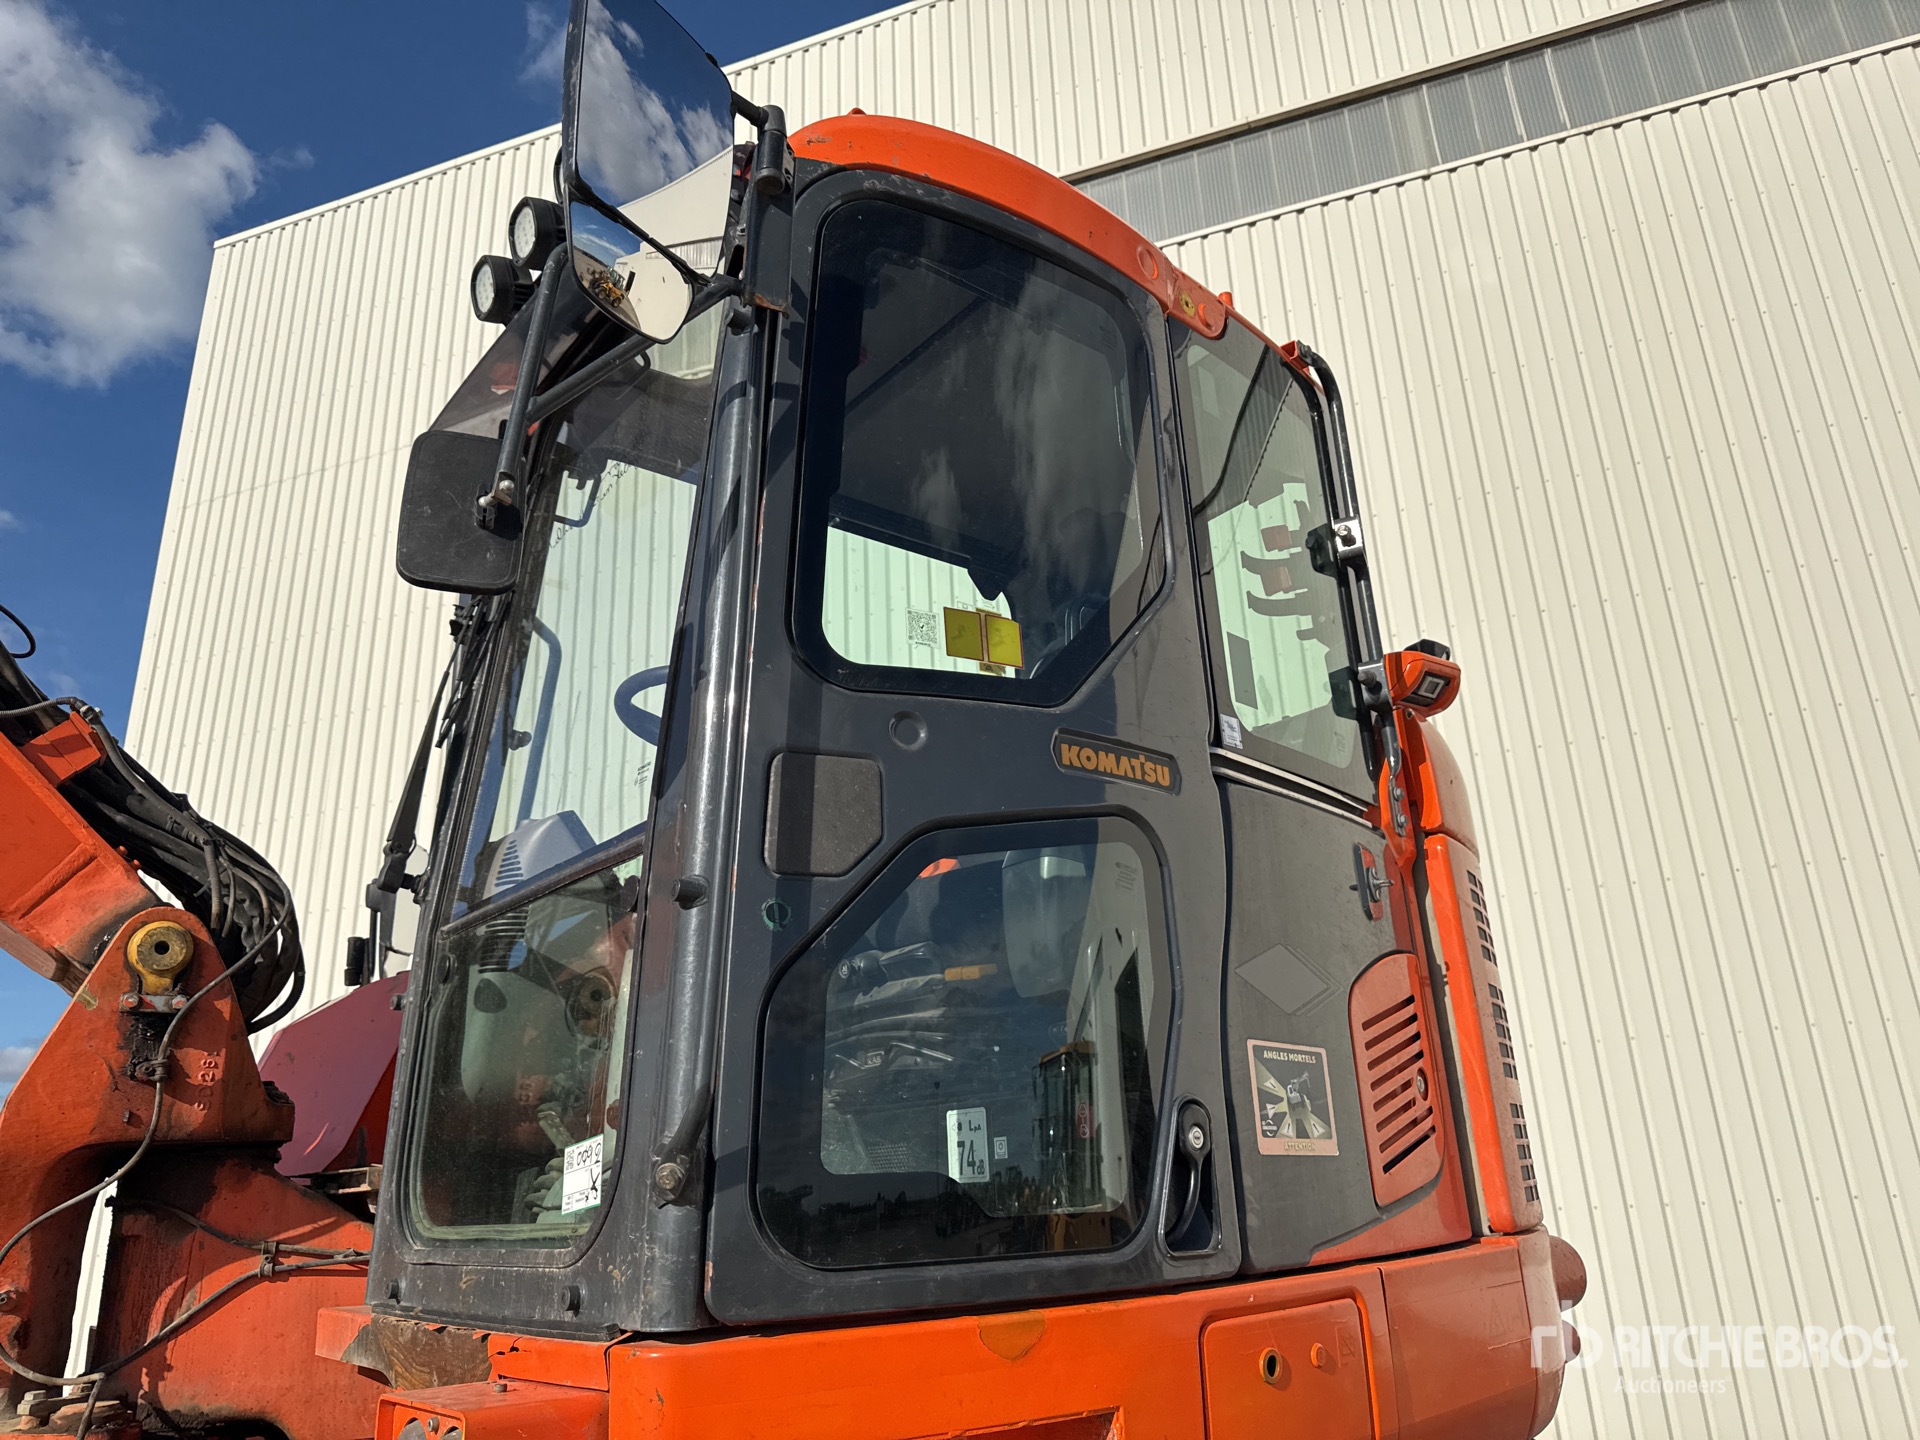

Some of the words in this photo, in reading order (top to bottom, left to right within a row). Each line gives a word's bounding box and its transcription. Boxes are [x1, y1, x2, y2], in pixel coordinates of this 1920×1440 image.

[1060, 743, 1171, 786] KOMATSU
[1263, 1050, 1288, 1061] ANGLES
[1288, 1053, 1316, 1064] MORTELS
[957, 1140, 976, 1175] 74
[1284, 1142, 1316, 1151] ATTENTION
